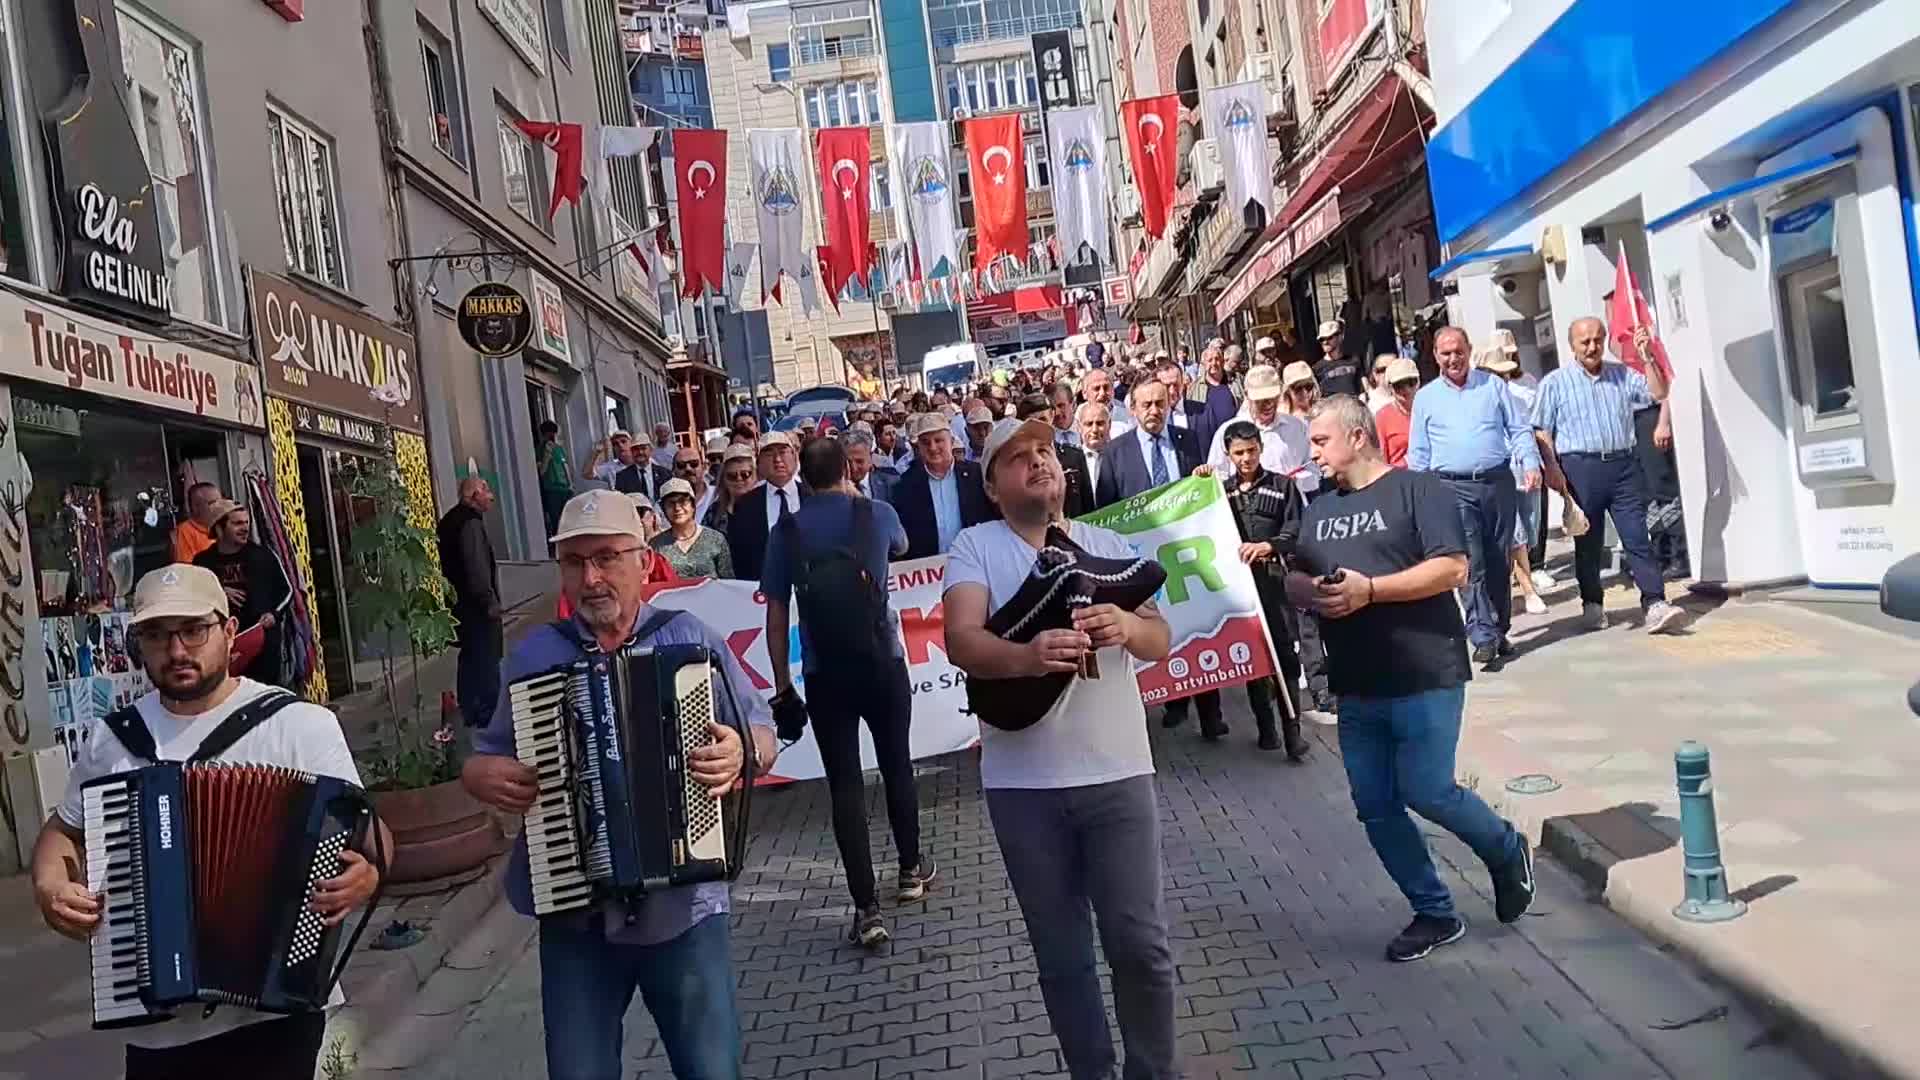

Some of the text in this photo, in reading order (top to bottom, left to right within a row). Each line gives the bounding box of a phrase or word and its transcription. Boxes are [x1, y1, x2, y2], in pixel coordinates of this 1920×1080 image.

[80, 183, 138, 255] Ela
[468, 297, 521, 314] MAKKAS
[24, 309, 218, 415] Tuğan Tuhafiye
[311, 313, 412, 401] MAKKAS
[1125, 497, 1147, 510] 200
[1087, 514, 1119, 528] ILLIK
[1316, 510, 1388, 541] USPA
[888, 565, 945, 592] EMM
[1175, 663, 1254, 692] artvinbeltr
[158, 794, 173, 849] HOHNER
